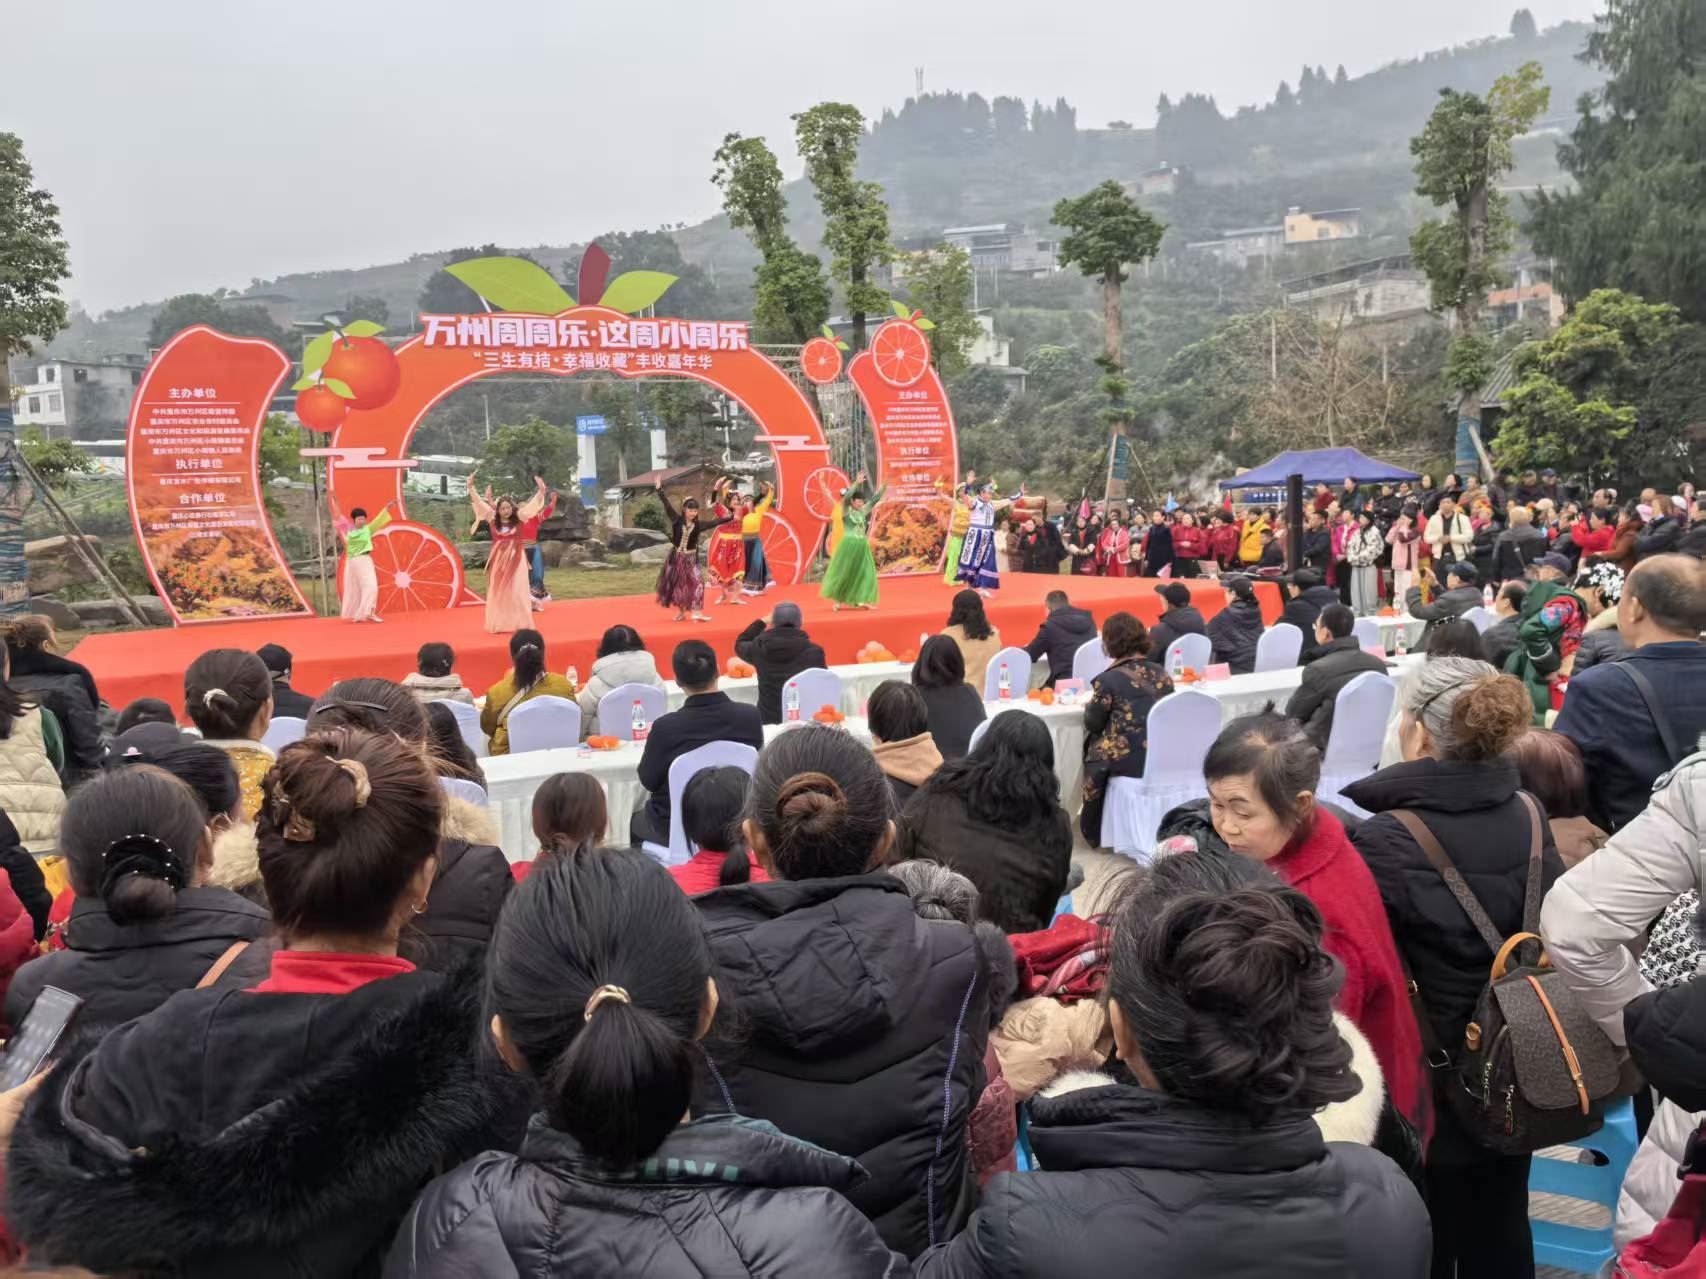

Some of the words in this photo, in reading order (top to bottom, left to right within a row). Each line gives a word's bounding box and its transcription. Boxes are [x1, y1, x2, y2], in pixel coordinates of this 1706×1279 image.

[422, 315, 749, 349] 万州周周乐·这周小周乐
[168, 388, 217, 399] 主办单位
[175, 458, 224, 470] 执行单位
[179, 492, 226, 505] 合作单位
